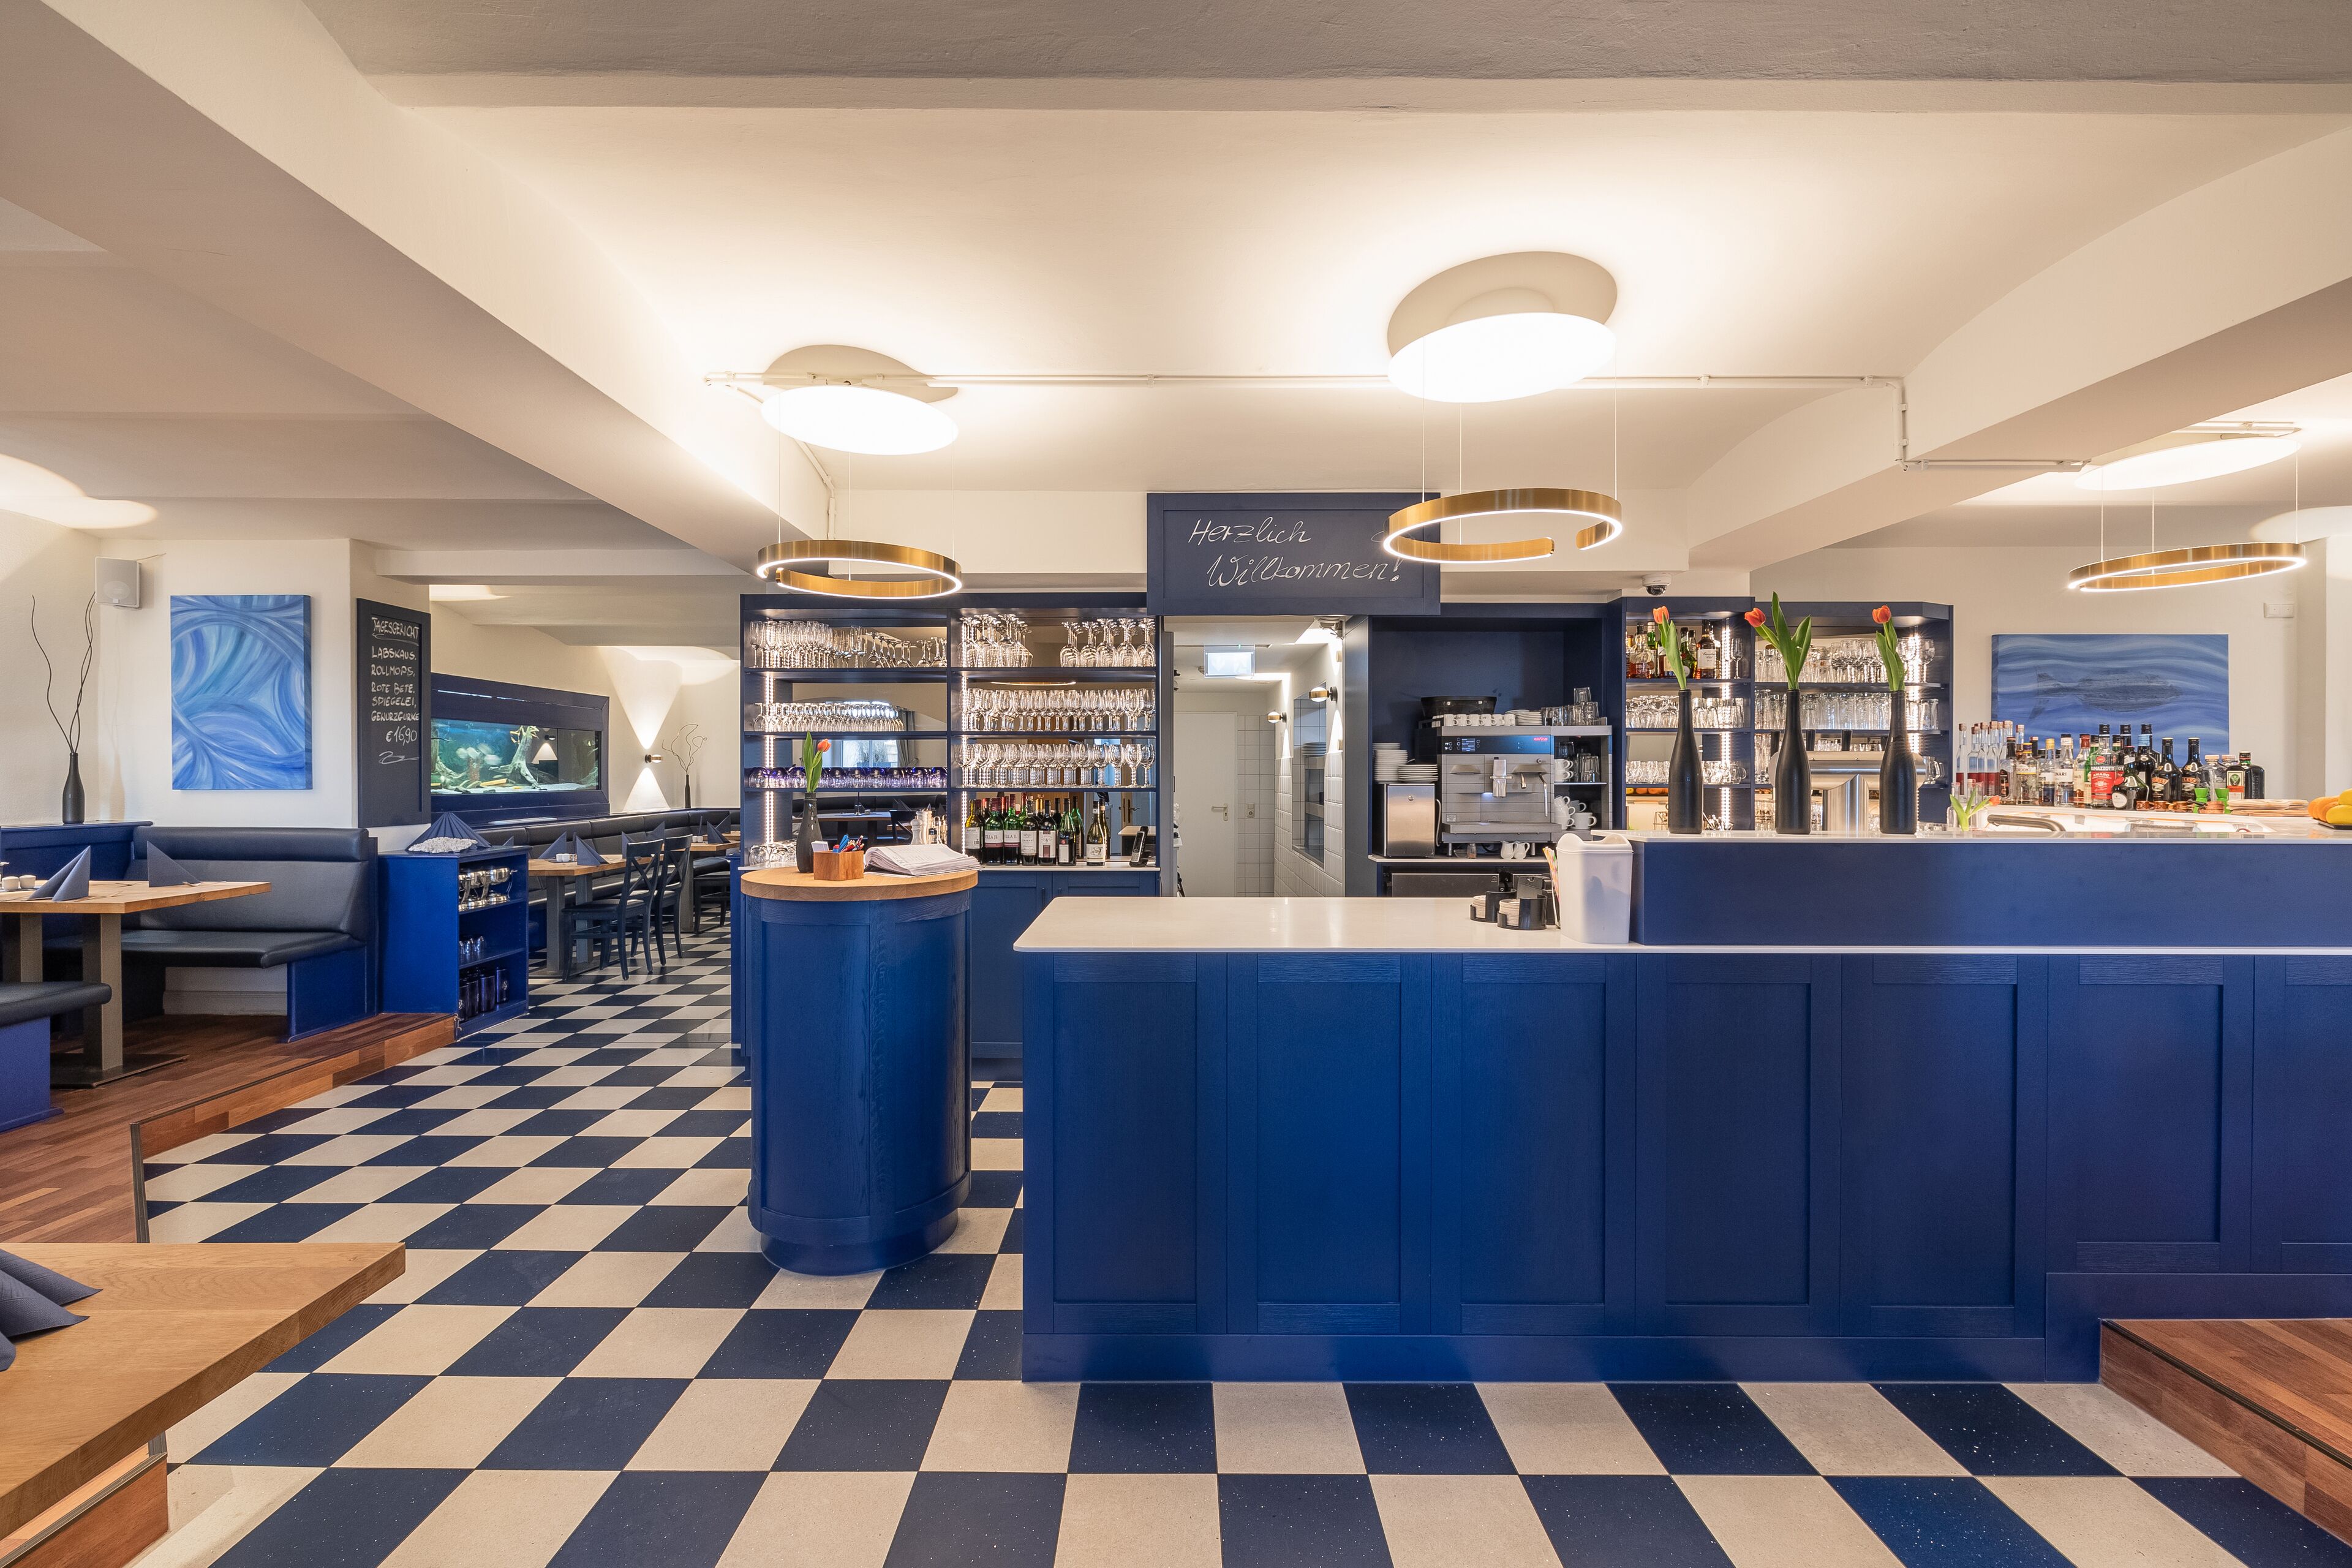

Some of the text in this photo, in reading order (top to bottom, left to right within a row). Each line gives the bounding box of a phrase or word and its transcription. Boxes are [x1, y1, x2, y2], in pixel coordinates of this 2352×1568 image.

[1187, 516, 1311, 546] Herzlich
[1207, 554, 1403, 587] Willkommen!
[371, 617, 420, 639] TAGESGERICHT
[371, 681, 391, 693] ROTE
